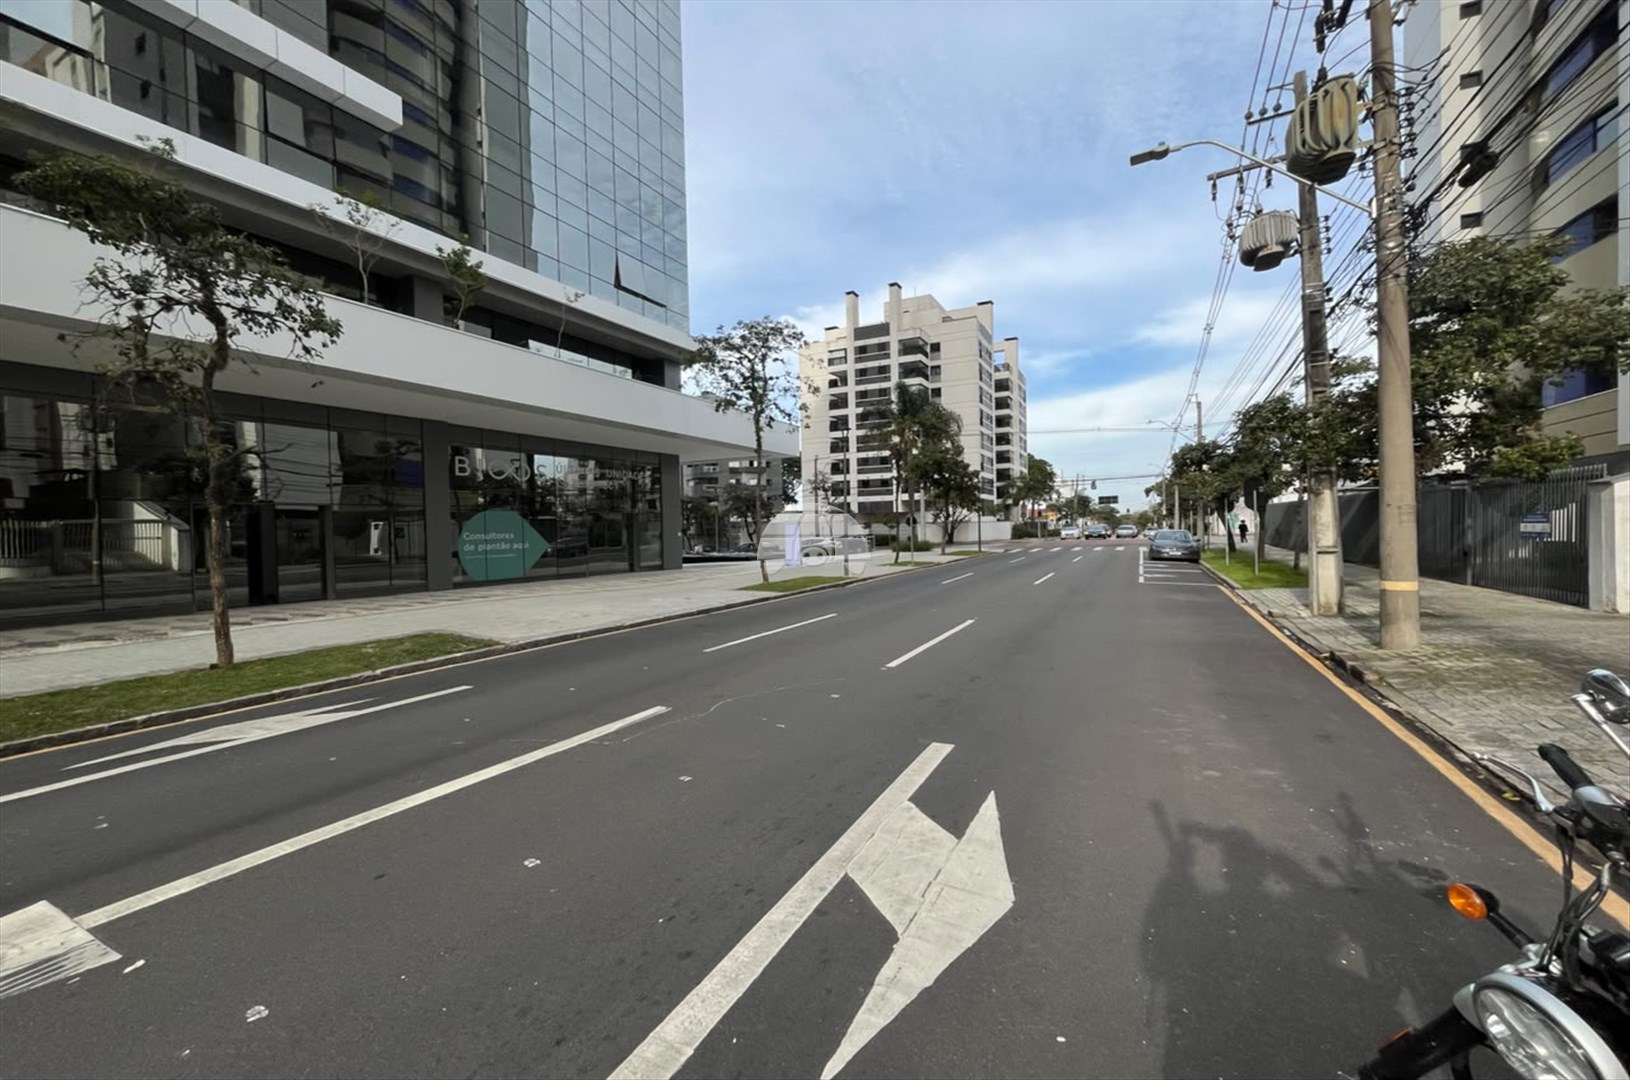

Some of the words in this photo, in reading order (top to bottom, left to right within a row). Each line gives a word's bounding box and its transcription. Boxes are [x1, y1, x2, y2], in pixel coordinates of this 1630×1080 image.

[463, 531, 514, 541] Consultores
[463, 543, 475, 552] de
[477, 541, 511, 553] plantão
[513, 540, 530, 551] aqui
